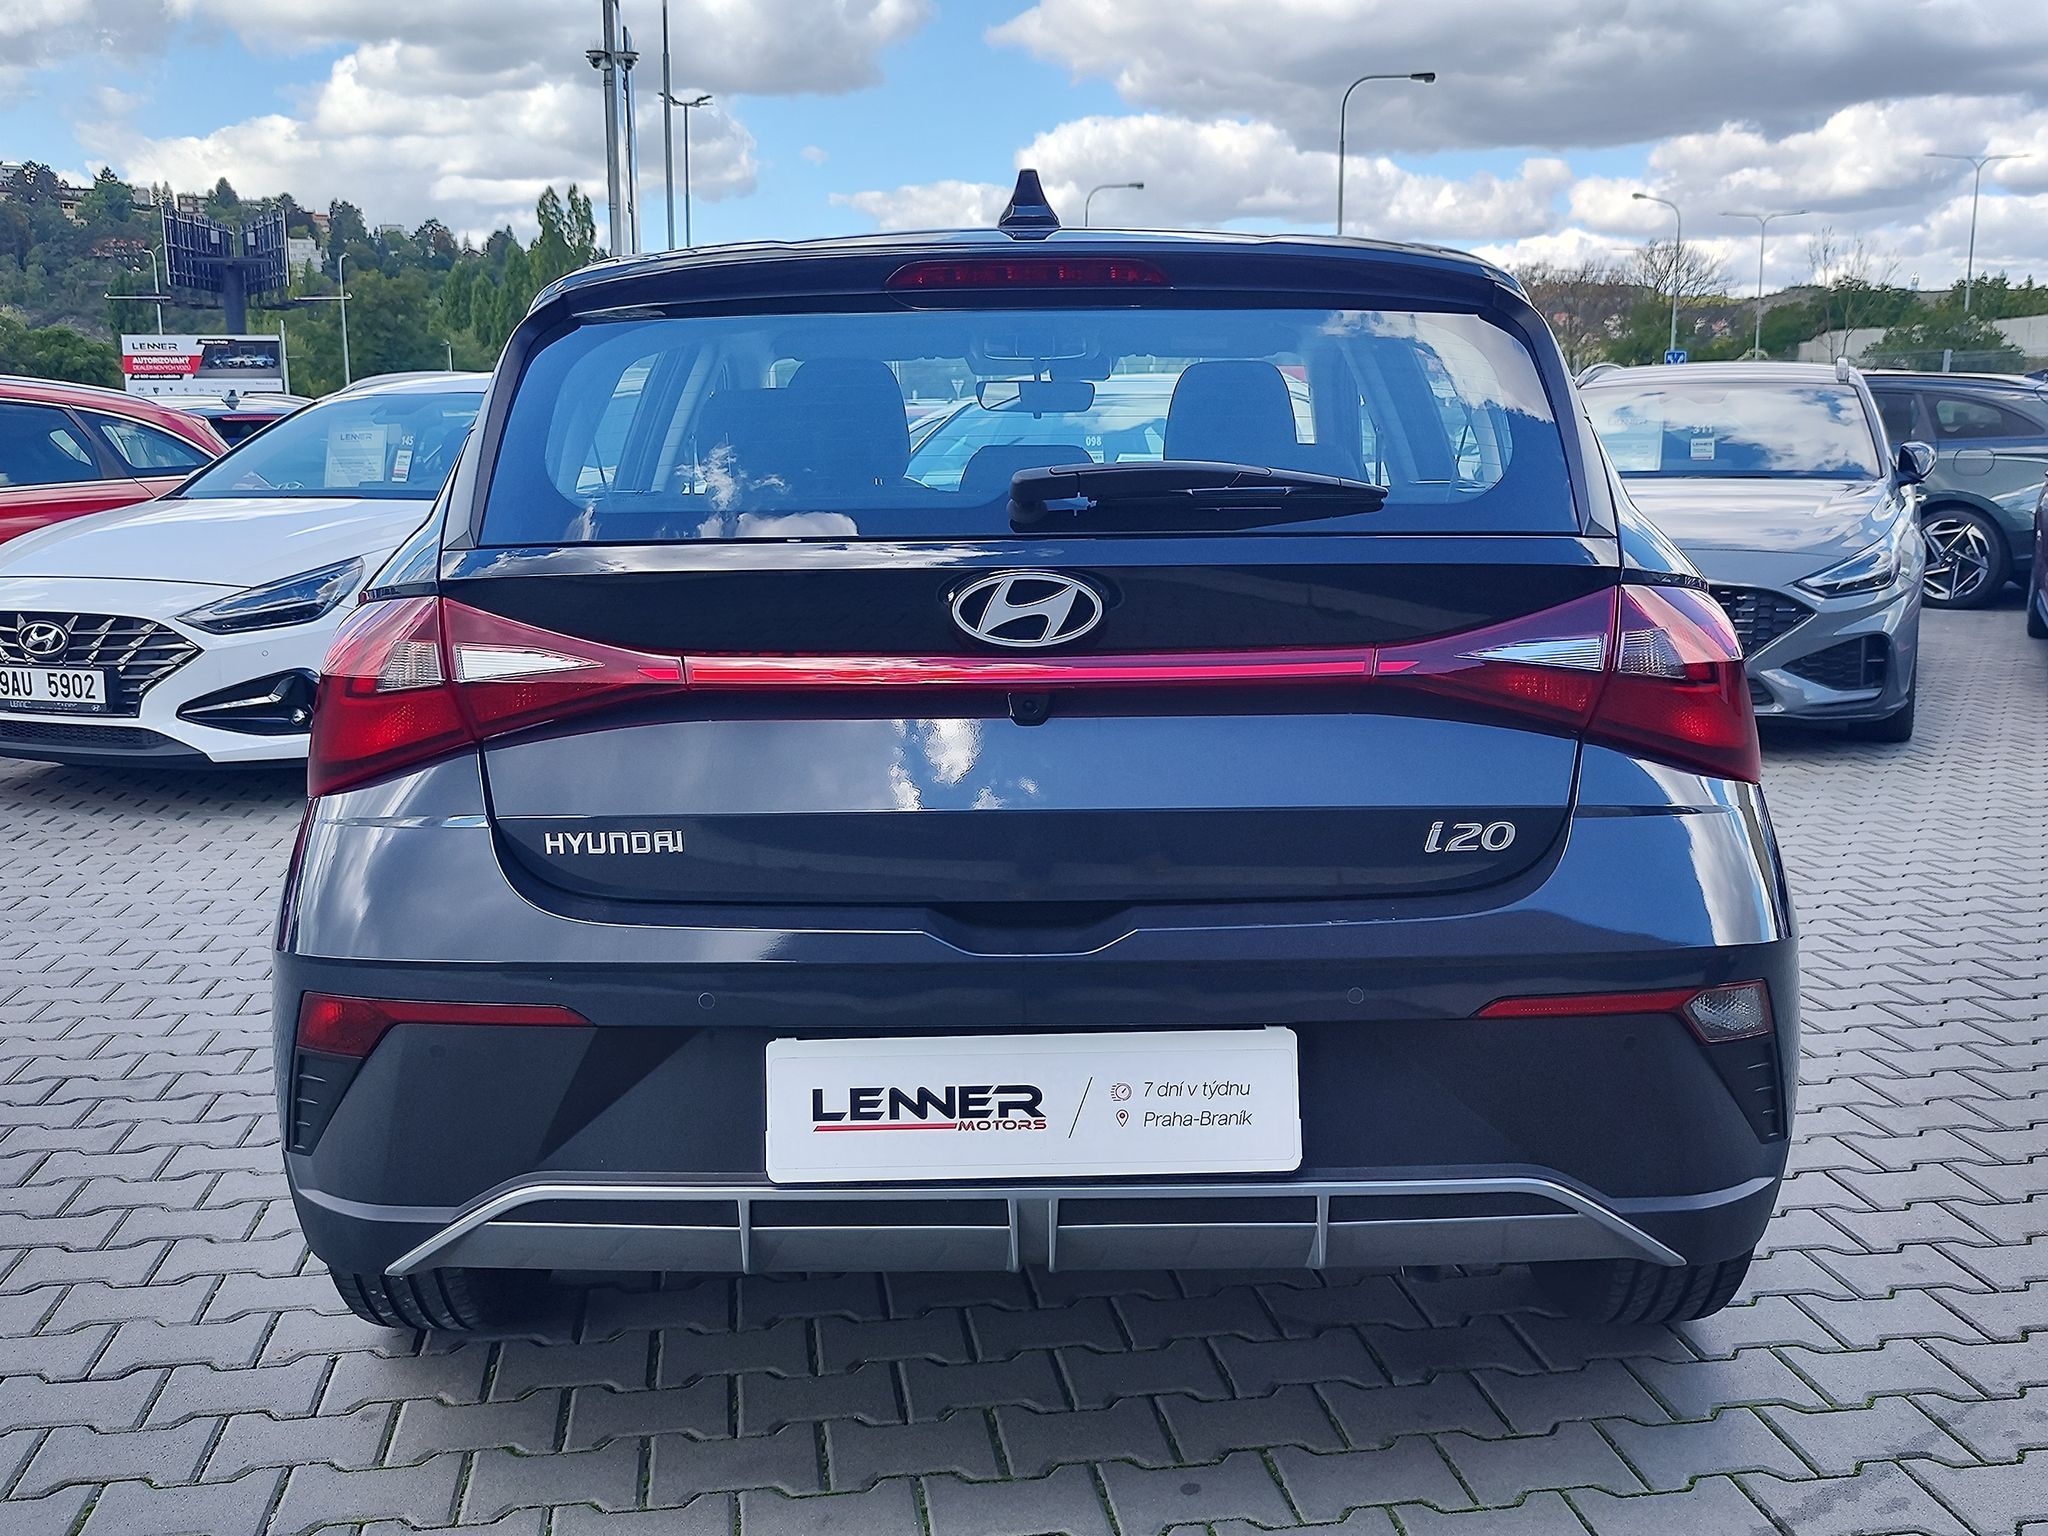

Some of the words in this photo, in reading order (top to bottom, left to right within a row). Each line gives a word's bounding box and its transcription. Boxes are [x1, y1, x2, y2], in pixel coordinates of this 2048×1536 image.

[131, 342, 178, 350] LENNER
[401, 435, 414, 446] 145
[1085, 436, 1102, 447] 098
[0, 671, 33, 697] 9AU
[47, 672, 96, 699] 5902
[544, 830, 685, 855] HYUNDAI
[1424, 821, 1516, 853] i20
[1144, 1081, 1154, 1097] 7
[1157, 1081, 1185, 1097] dní
[1187, 1084, 1198, 1096] v
[1202, 1080, 1251, 1100] týdnu
[812, 1084, 1047, 1122] LENNER
[957, 1119, 1047, 1132] MOTORS
[1143, 1109, 1253, 1127] Praha-Braník
